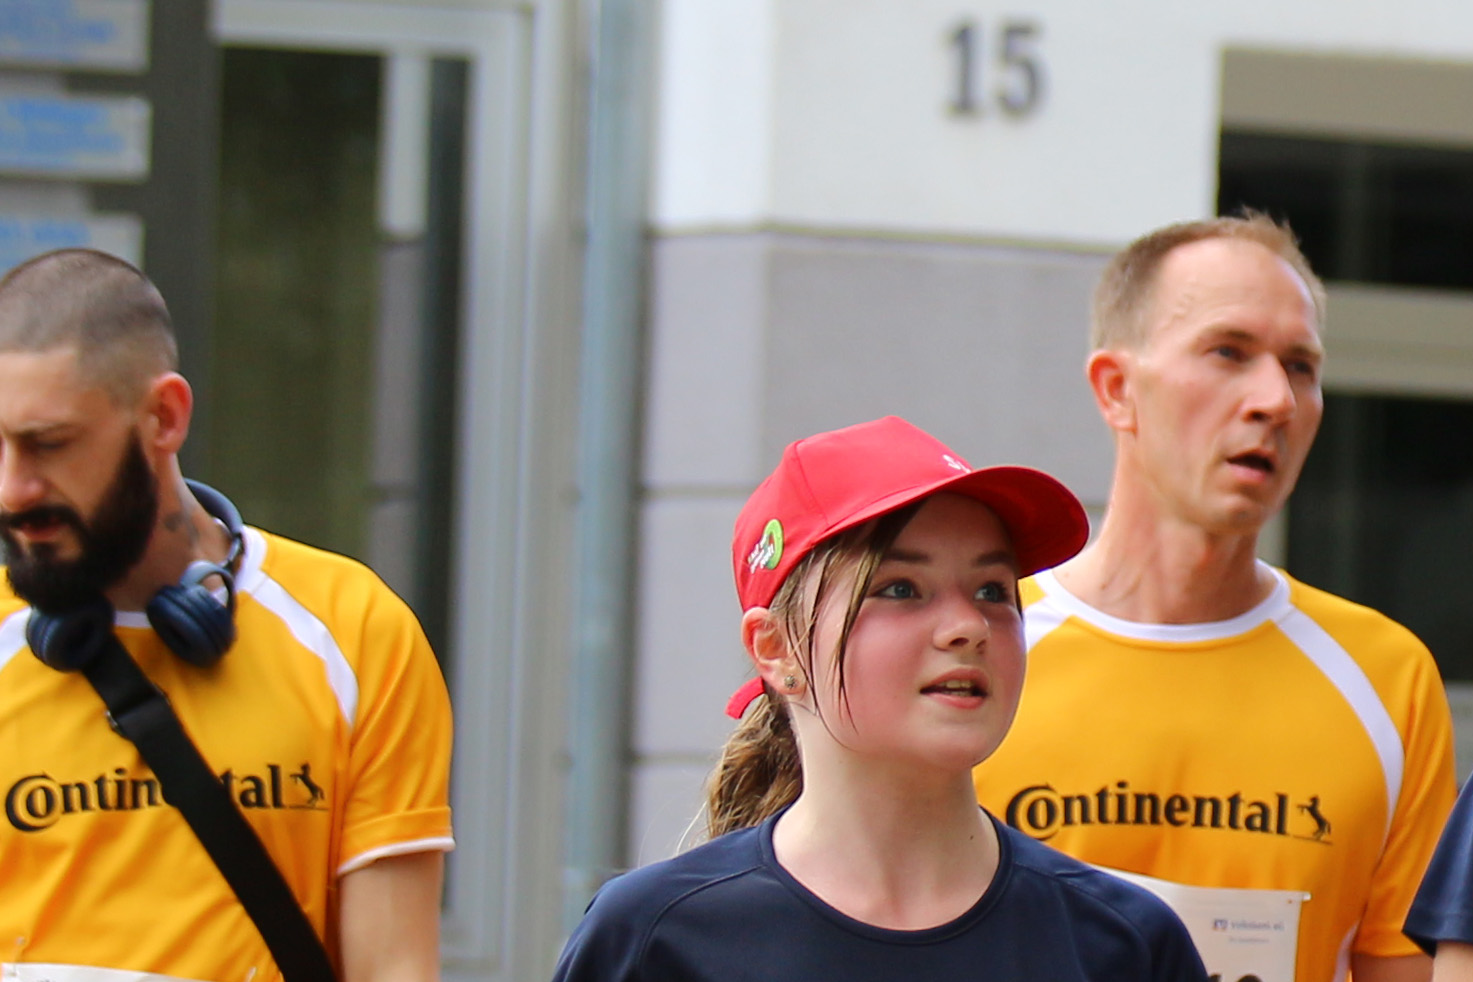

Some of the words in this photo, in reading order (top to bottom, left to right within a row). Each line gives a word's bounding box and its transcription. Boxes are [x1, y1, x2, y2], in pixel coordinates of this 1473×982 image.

[943, 22, 1047, 120] 15
[5, 763, 286, 832] Contintal
[1005, 780, 1289, 842] Continental
